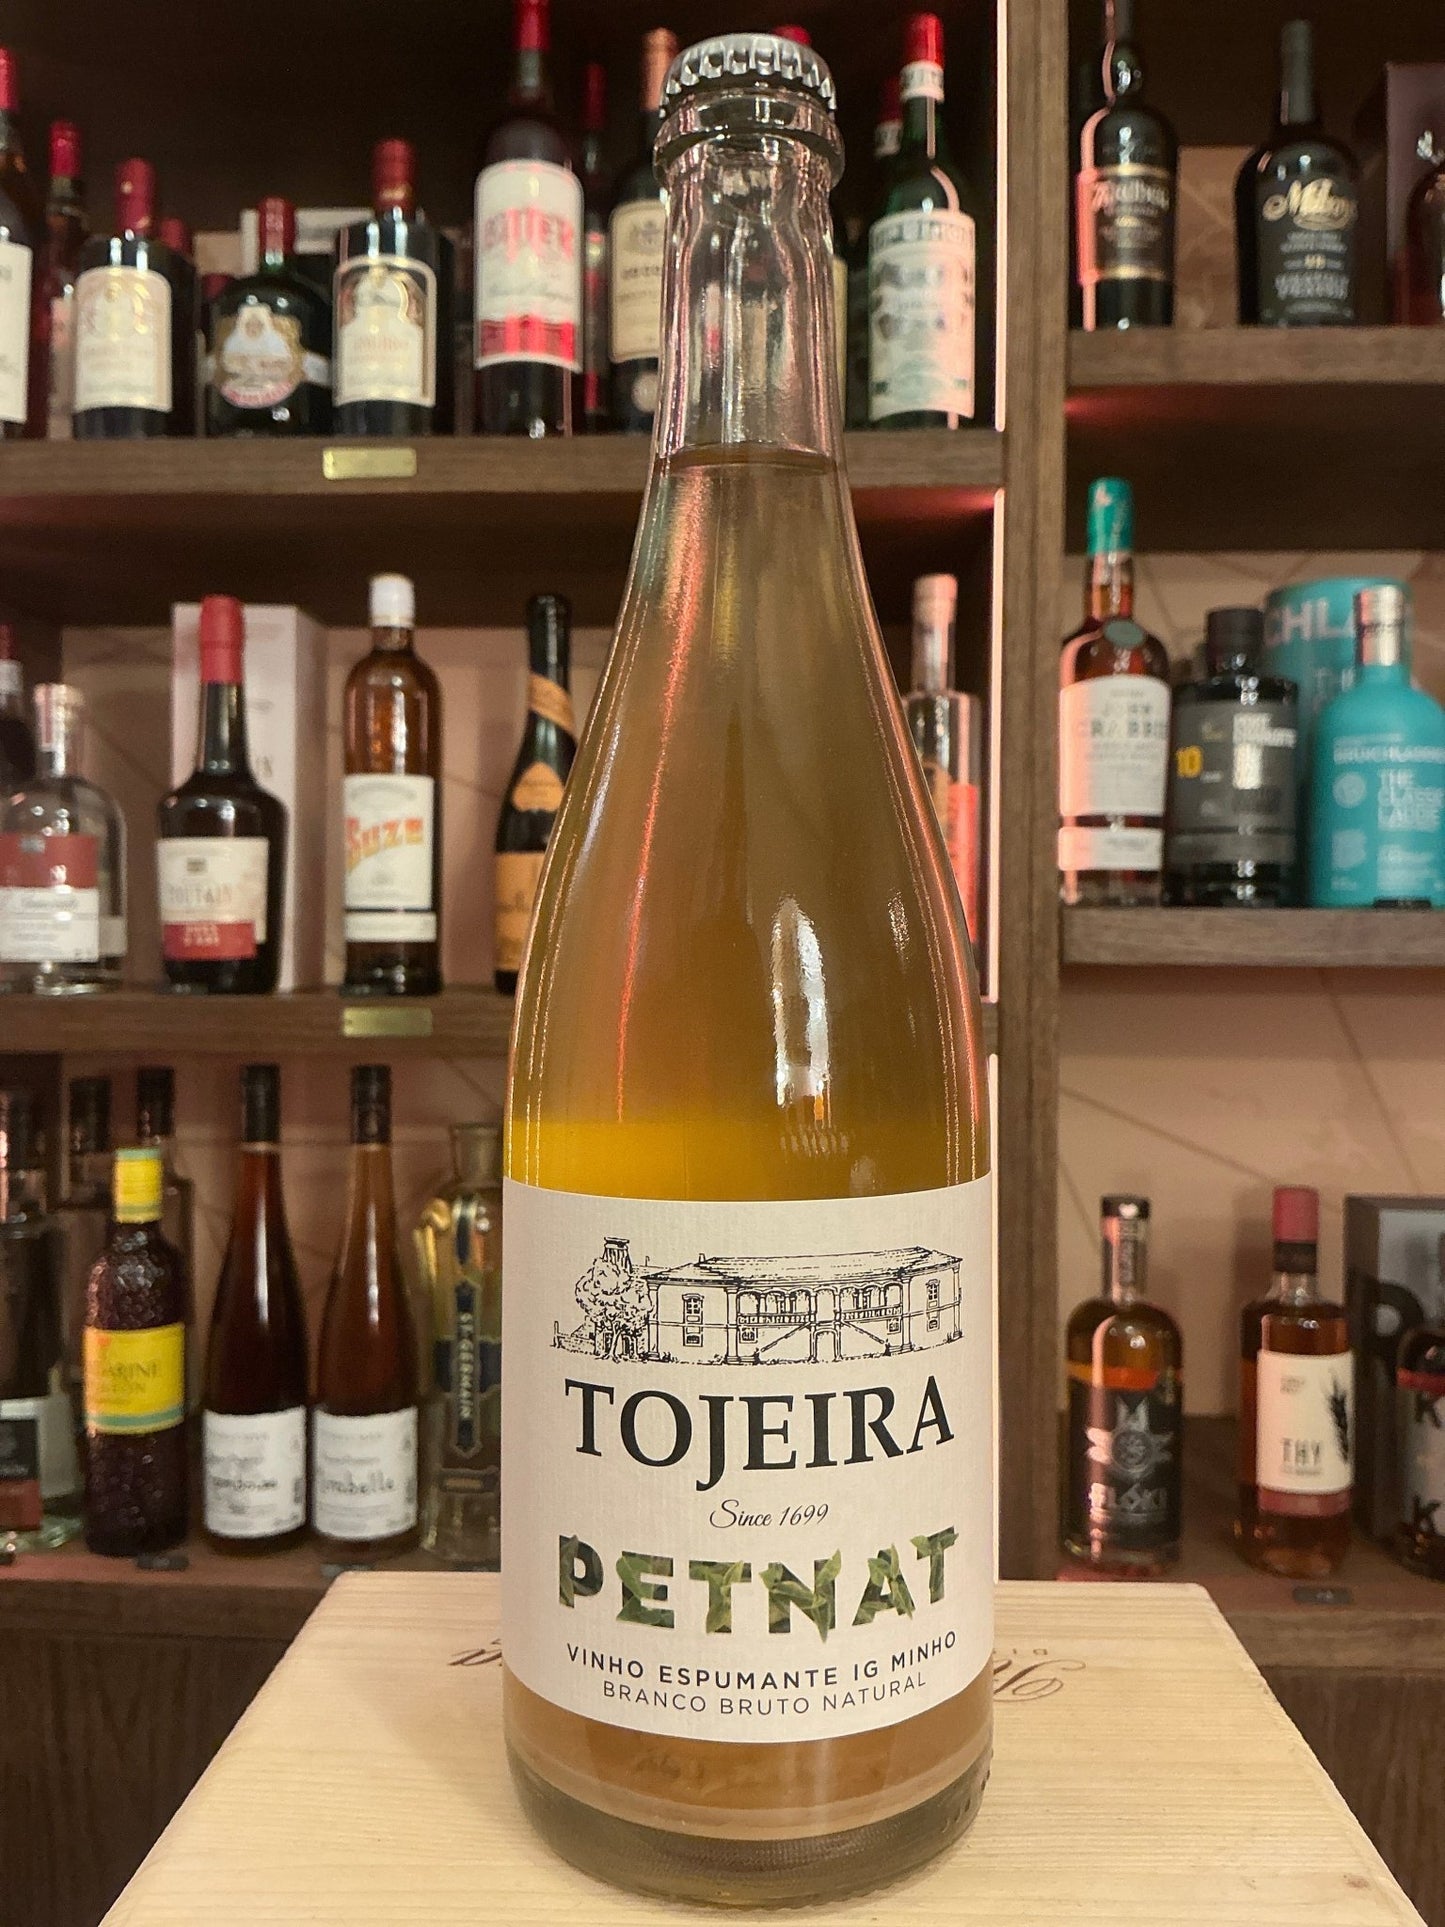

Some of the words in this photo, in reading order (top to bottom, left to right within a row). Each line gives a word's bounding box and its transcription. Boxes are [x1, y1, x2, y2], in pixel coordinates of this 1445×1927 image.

[564, 1375, 955, 1492] TOJEIRA
[709, 1498, 773, 1528] Since
[779, 1503, 830, 1527] 1699
[558, 1526, 960, 1643] PETNAT
[566, 1643, 645, 1680] VINHO
[658, 1664, 839, 1691] ESPUMANTE
[853, 1660, 879, 1682] IG
[890, 1631, 957, 1673] MINHO
[603, 1680, 706, 1712] BRANCO
[720, 1697, 810, 1716] BRUTO
[823, 1673, 927, 1711] NATURAL
